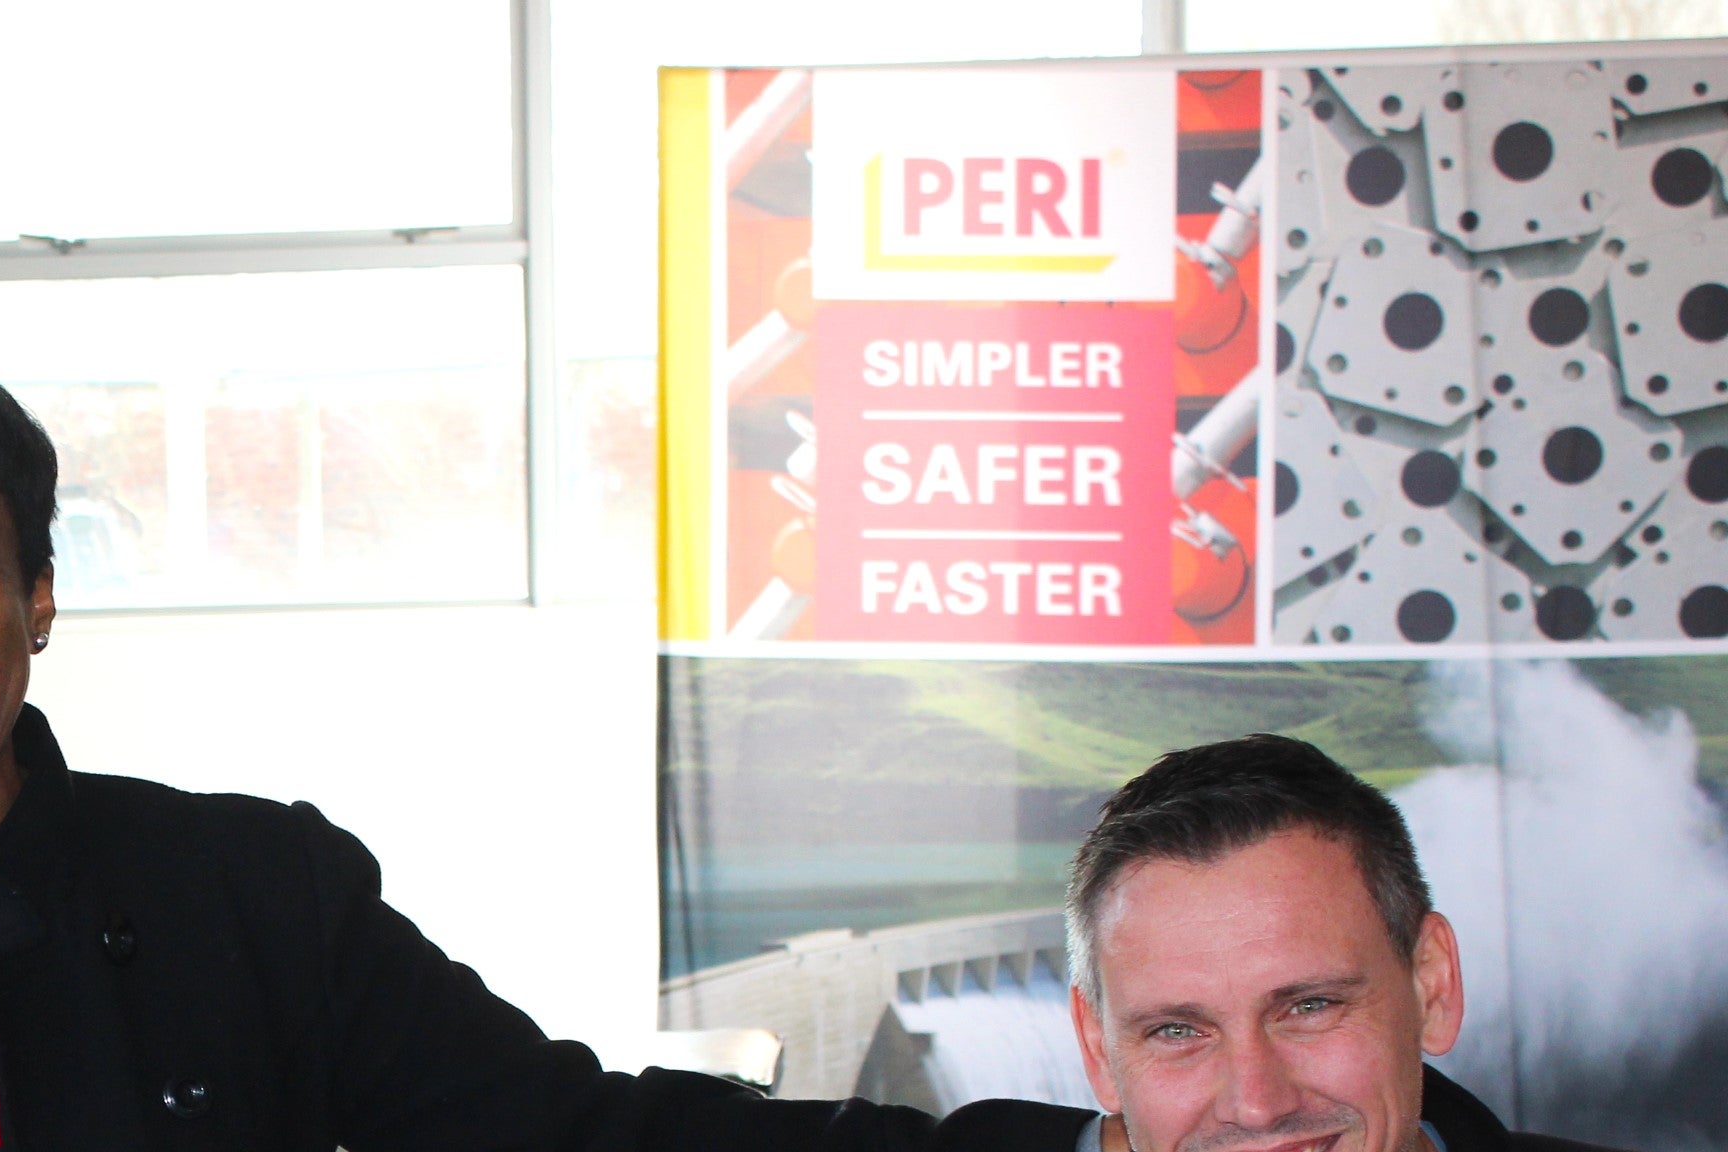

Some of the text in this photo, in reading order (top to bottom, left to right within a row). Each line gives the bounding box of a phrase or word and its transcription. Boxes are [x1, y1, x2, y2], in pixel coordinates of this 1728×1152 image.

[902, 157, 1103, 238] PERI
[862, 340, 1123, 389] SIMPLER
[861, 442, 1123, 506] SAFER
[860, 560, 1123, 616] FASTER
